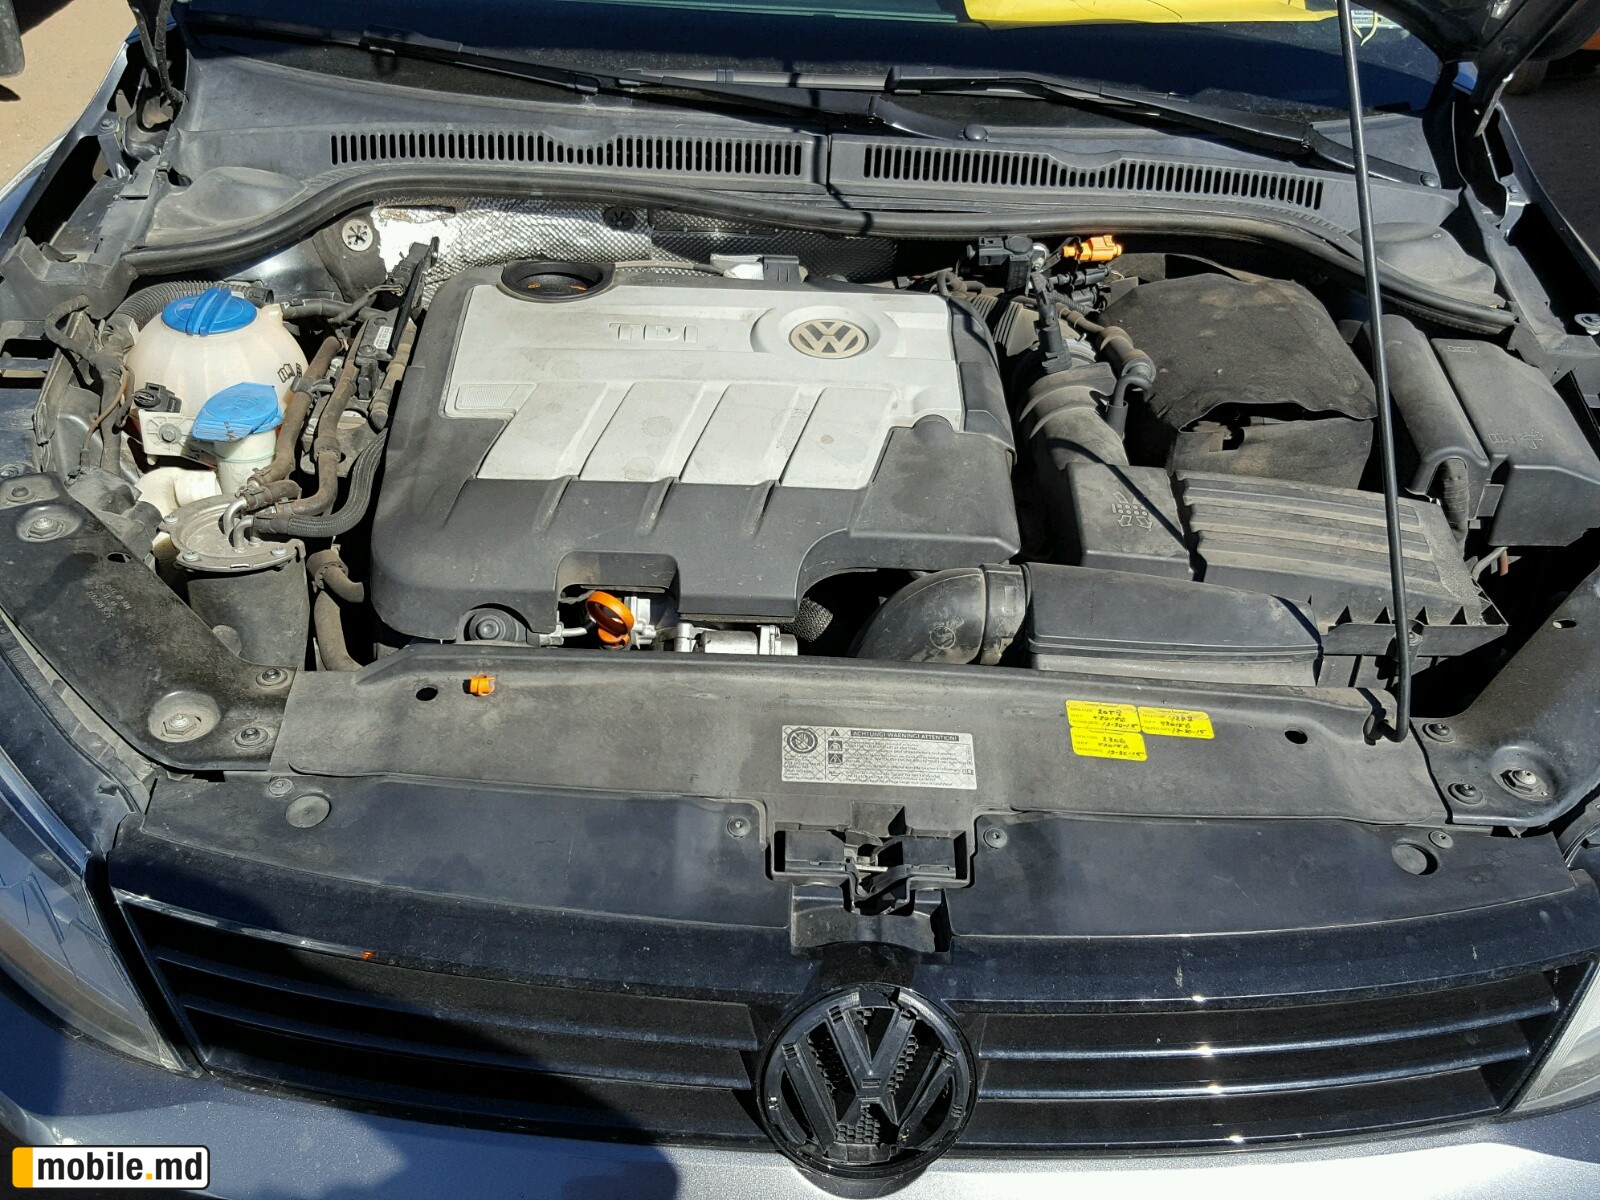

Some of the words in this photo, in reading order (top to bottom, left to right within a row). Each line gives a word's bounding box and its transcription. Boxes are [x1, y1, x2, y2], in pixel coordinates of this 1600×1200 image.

[609, 322, 698, 342] TDI
[789, 319, 869, 359] VW
[852, 730, 886, 738] ACHTUNG!
[888, 732, 919, 740] WARNING!
[921, 734, 958, 742] ATTENTION!
